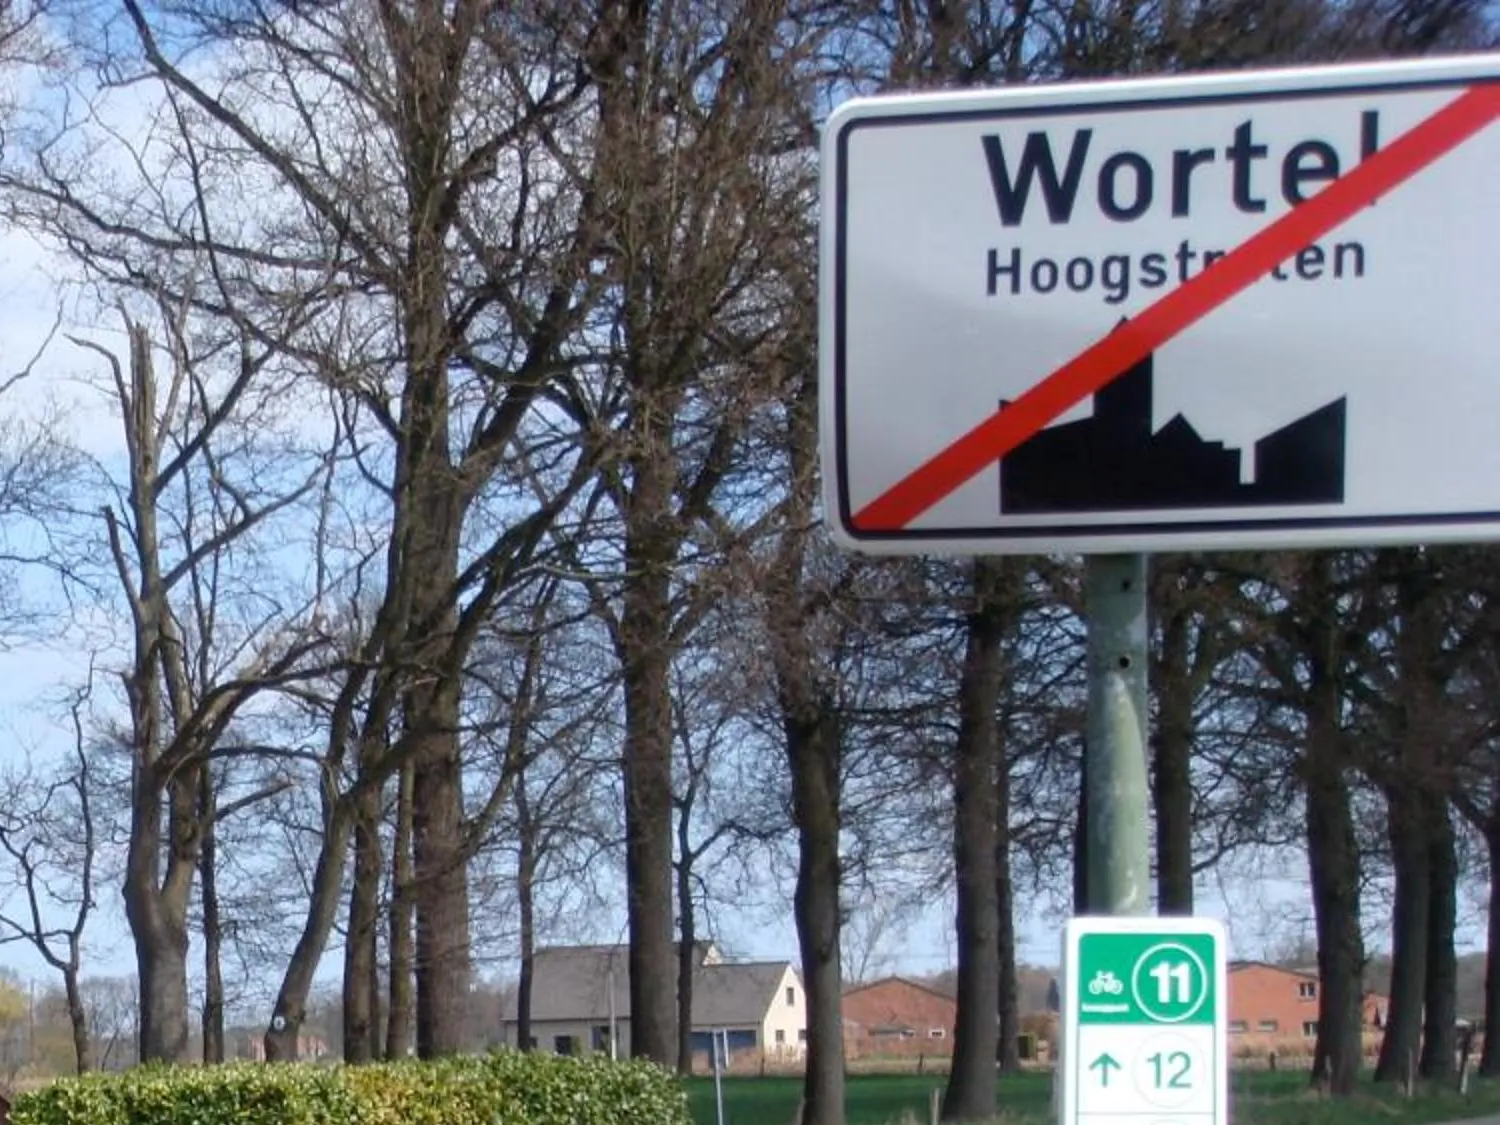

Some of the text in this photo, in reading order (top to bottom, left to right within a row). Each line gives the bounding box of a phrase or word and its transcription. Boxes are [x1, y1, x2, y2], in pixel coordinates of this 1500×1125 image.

[980, 109, 1379, 227] Wortel
[985, 238, 1365, 304] Hoogstren
[1149, 960, 1192, 1004] 11
[1146, 1050, 1192, 1090] 12
